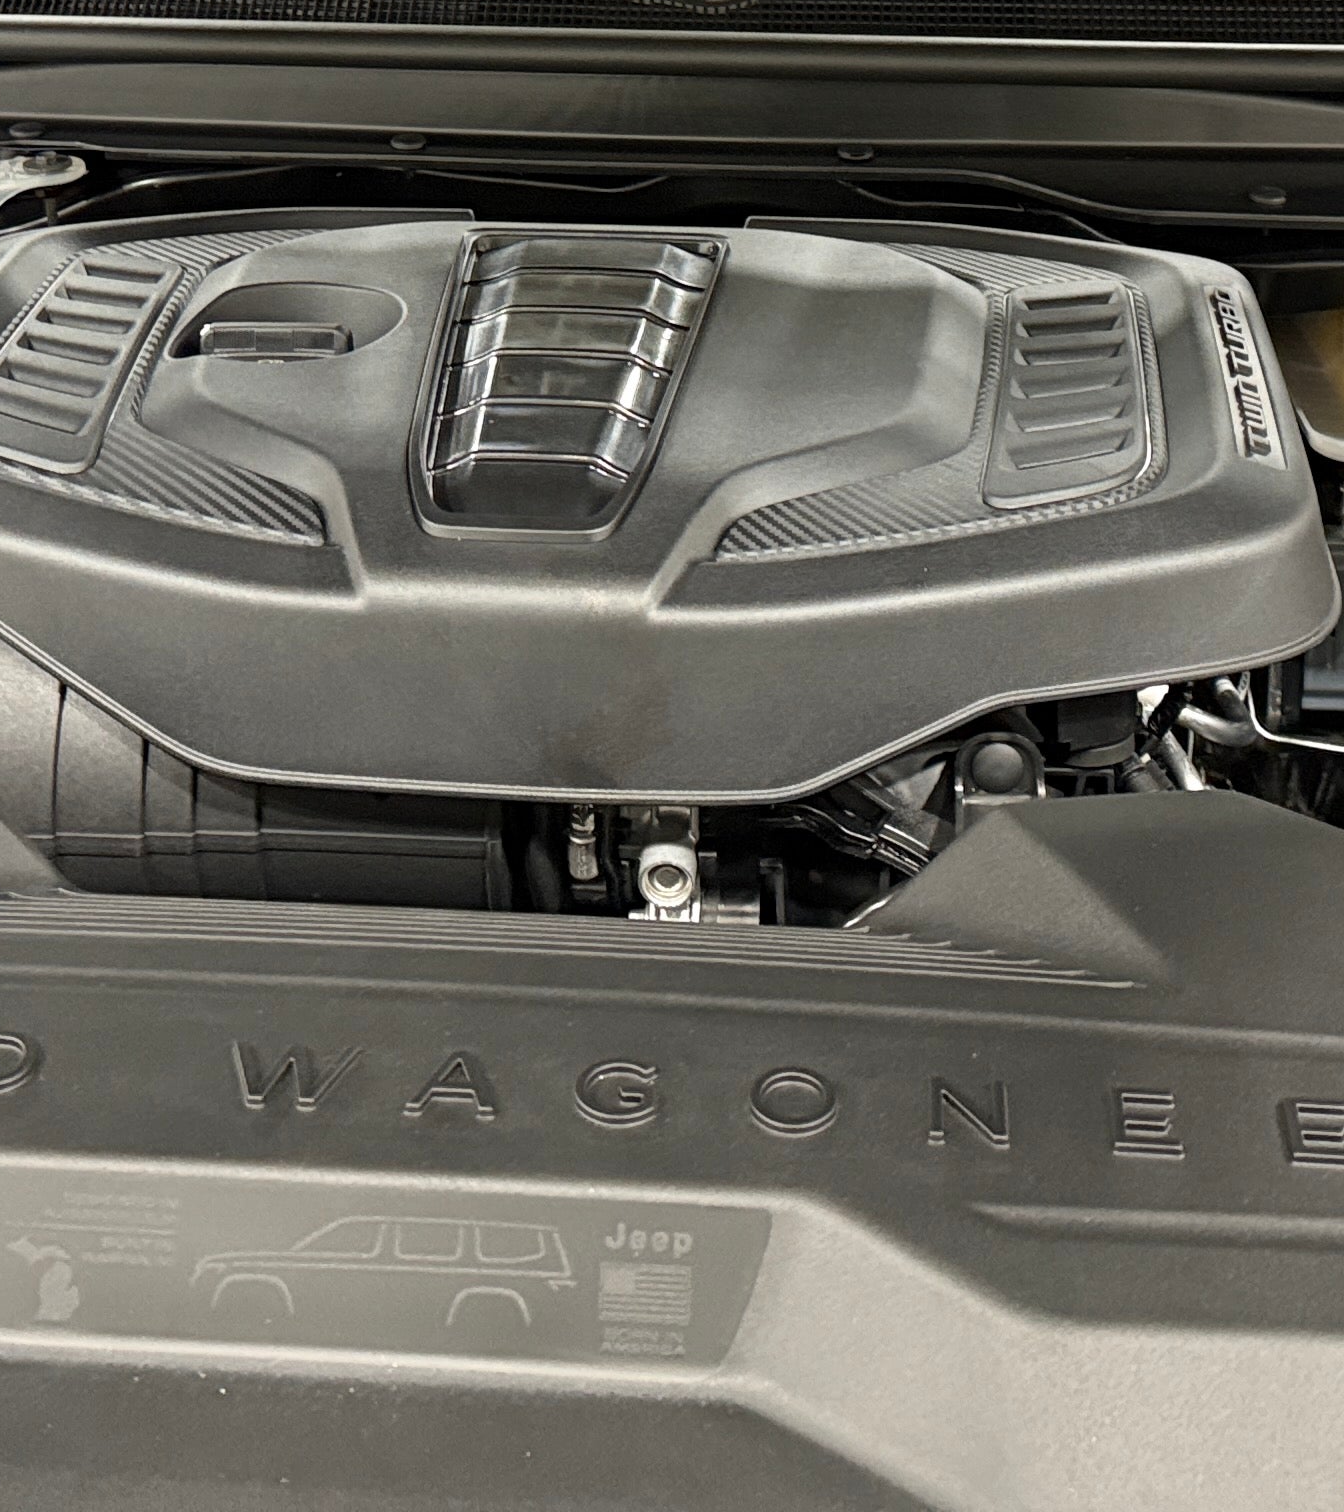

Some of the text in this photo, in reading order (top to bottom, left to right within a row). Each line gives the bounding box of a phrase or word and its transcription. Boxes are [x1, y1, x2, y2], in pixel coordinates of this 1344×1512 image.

[1210, 289, 1272, 457] TWIN TURBO
[604, 1222, 694, 1259] Jeep
